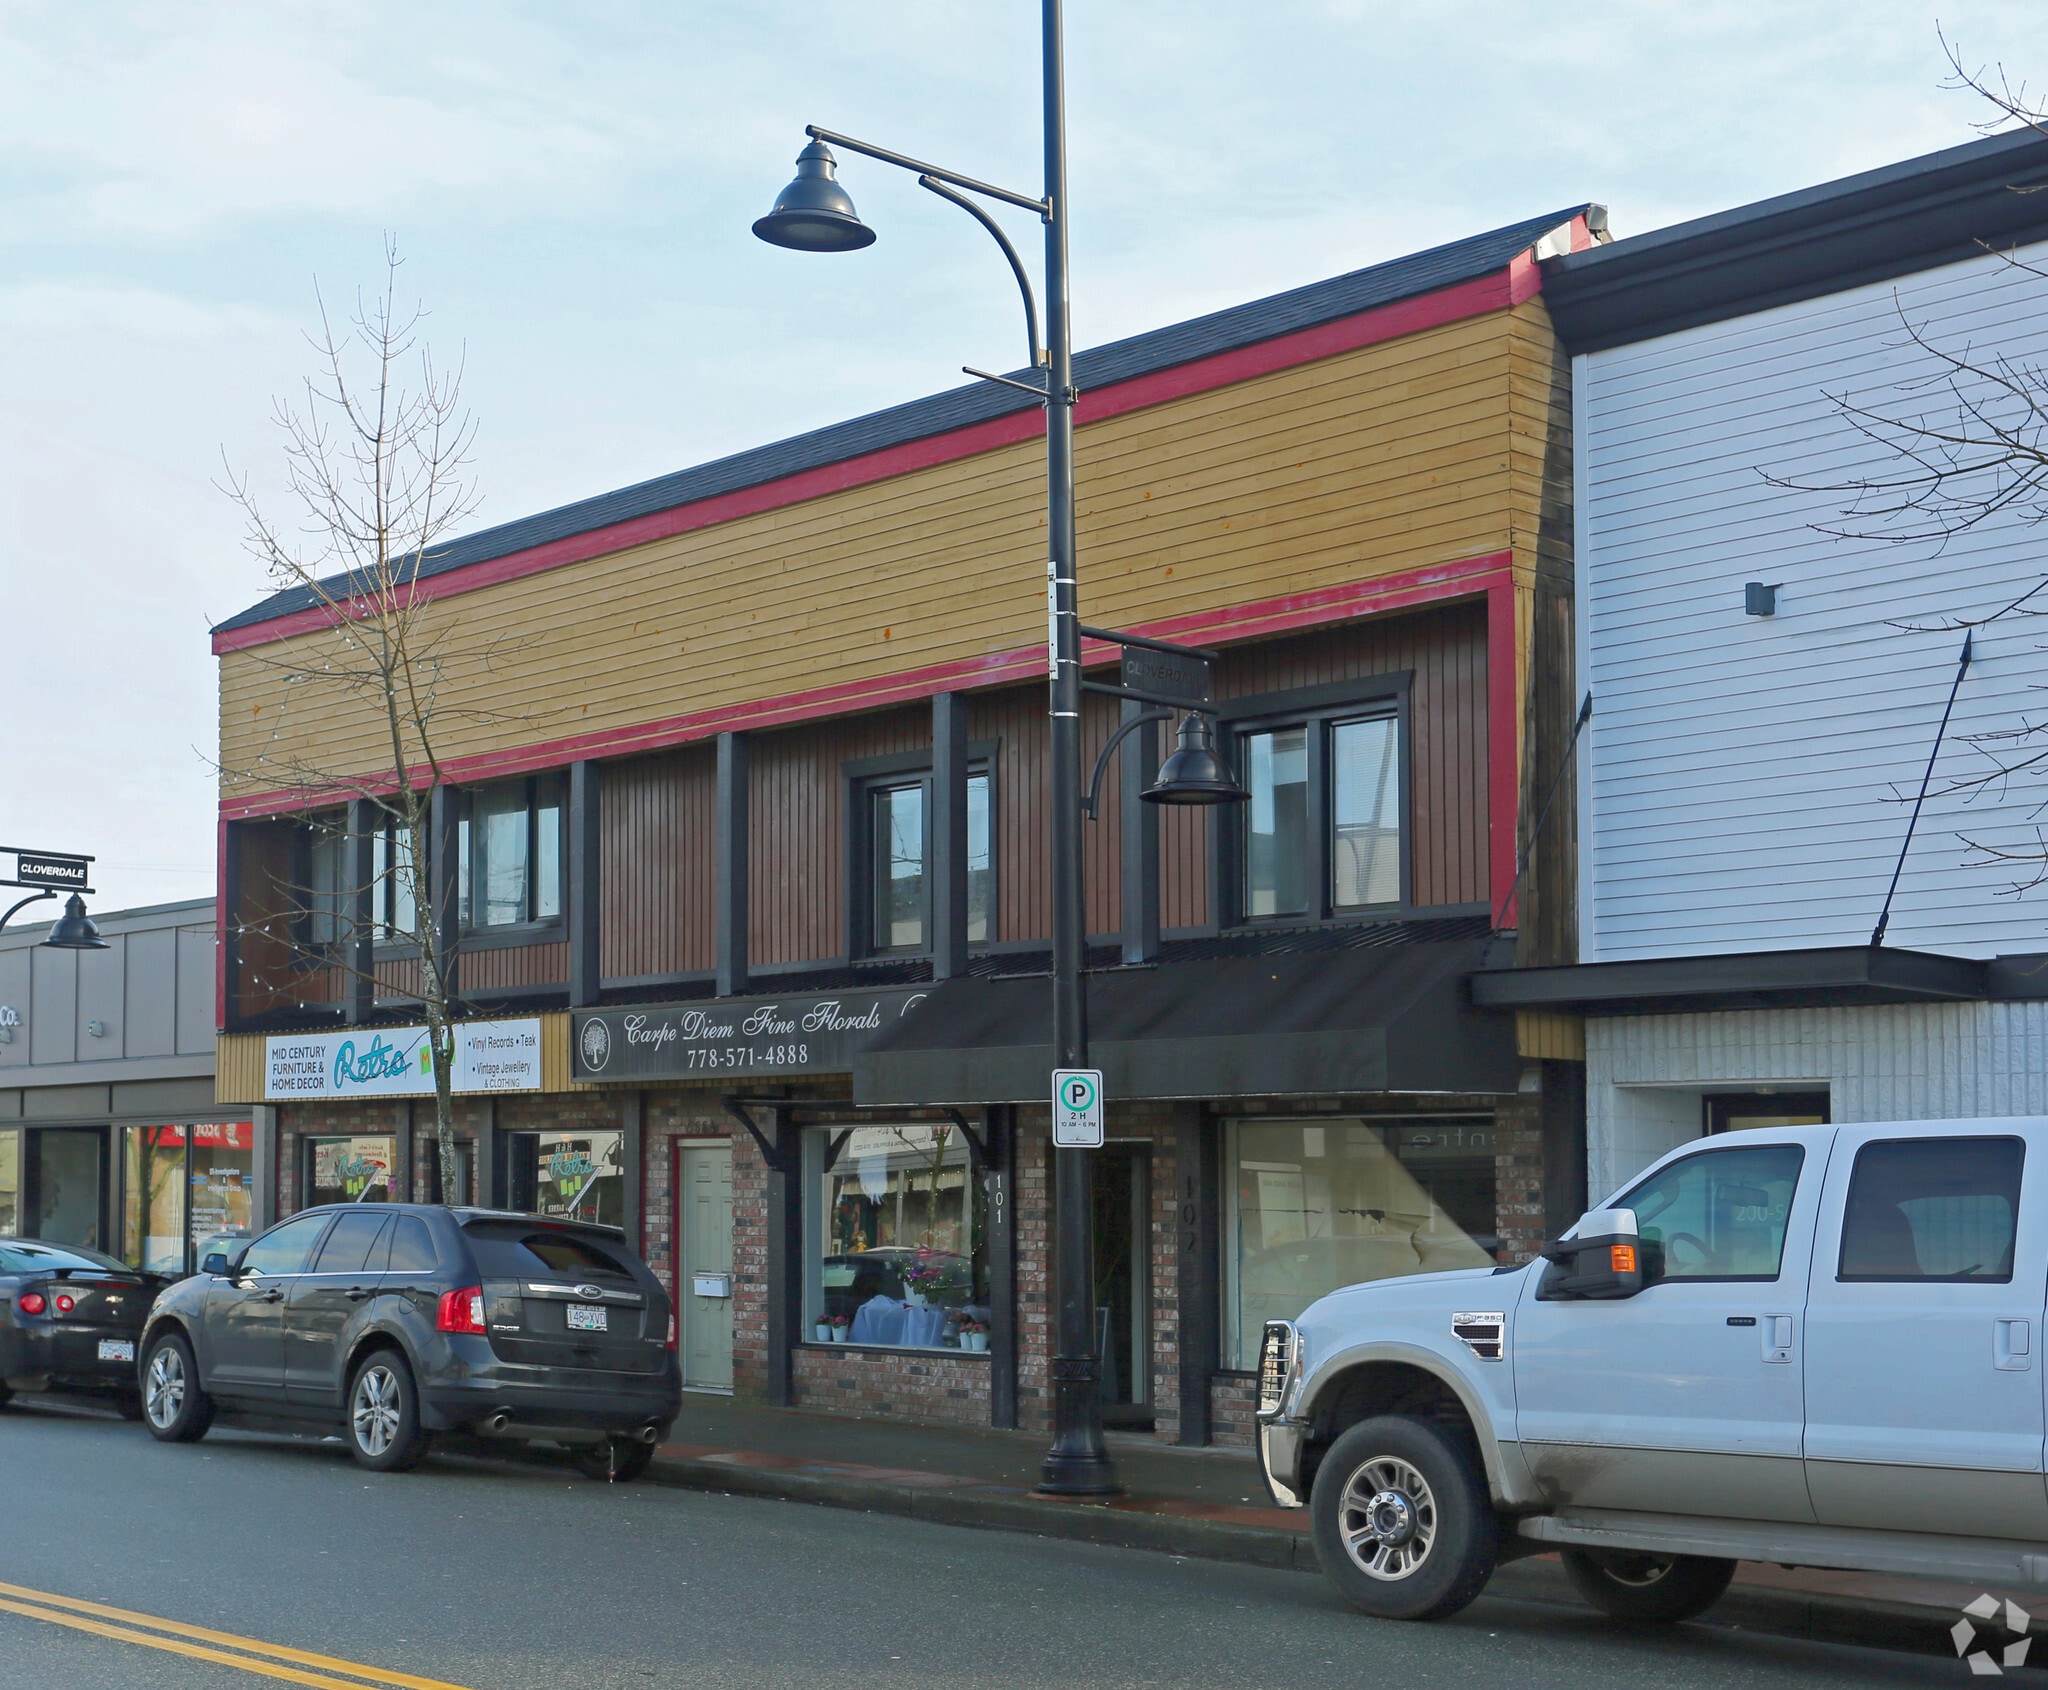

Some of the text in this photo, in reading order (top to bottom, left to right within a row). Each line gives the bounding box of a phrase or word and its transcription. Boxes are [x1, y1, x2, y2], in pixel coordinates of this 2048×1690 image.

[1126, 661, 1204, 684] CLOVERDALE
[20, 863, 84, 878] CLOVERDALE
[624, 1000, 880, 1052] Carpe Diem Fine Florals
[471, 1034, 537, 1052] Vinyl Records Teak
[271, 1046, 327, 1060] MID CENTURY
[333, 1034, 413, 1089] Retro
[687, 1044, 808, 1069] 778-571-4888
[272, 1061, 324, 1075] FURNITURE &
[476, 1061, 531, 1078] Vintage Jewellery
[271, 1077, 325, 1090] HOME DECOR
[484, 1078, 520, 1088] & CLOTHING
[1072, 1085, 1086, 1104] P
[1070, 1112, 1086, 1120] 2 H
[551, 1149, 596, 1178] Retro
[995, 1174, 1004, 1224] 101
